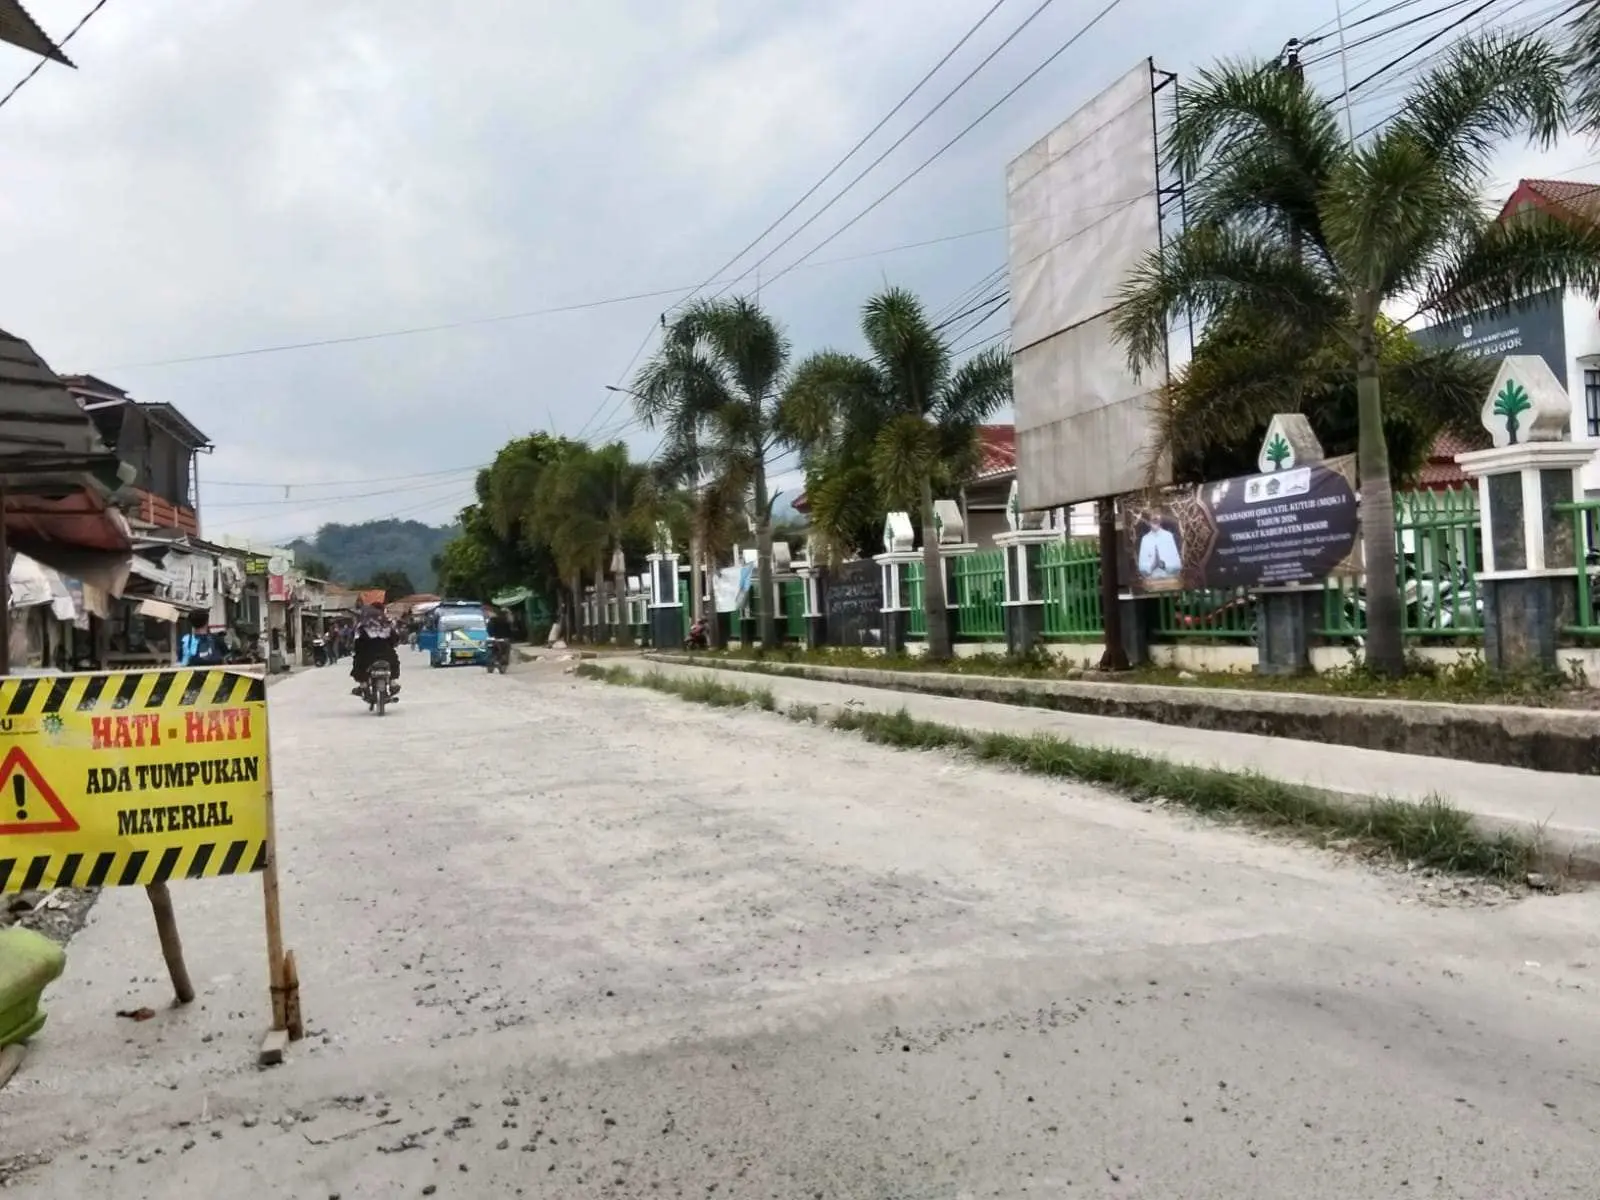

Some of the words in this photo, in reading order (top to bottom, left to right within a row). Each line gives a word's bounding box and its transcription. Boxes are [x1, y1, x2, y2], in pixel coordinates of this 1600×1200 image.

[91, 713, 161, 750] HATI
[185, 708, 252, 744] HATI
[86, 766, 133, 795] ADA
[135, 756, 259, 791] TUMPUKAN
[117, 801, 234, 837] MATERIAL
